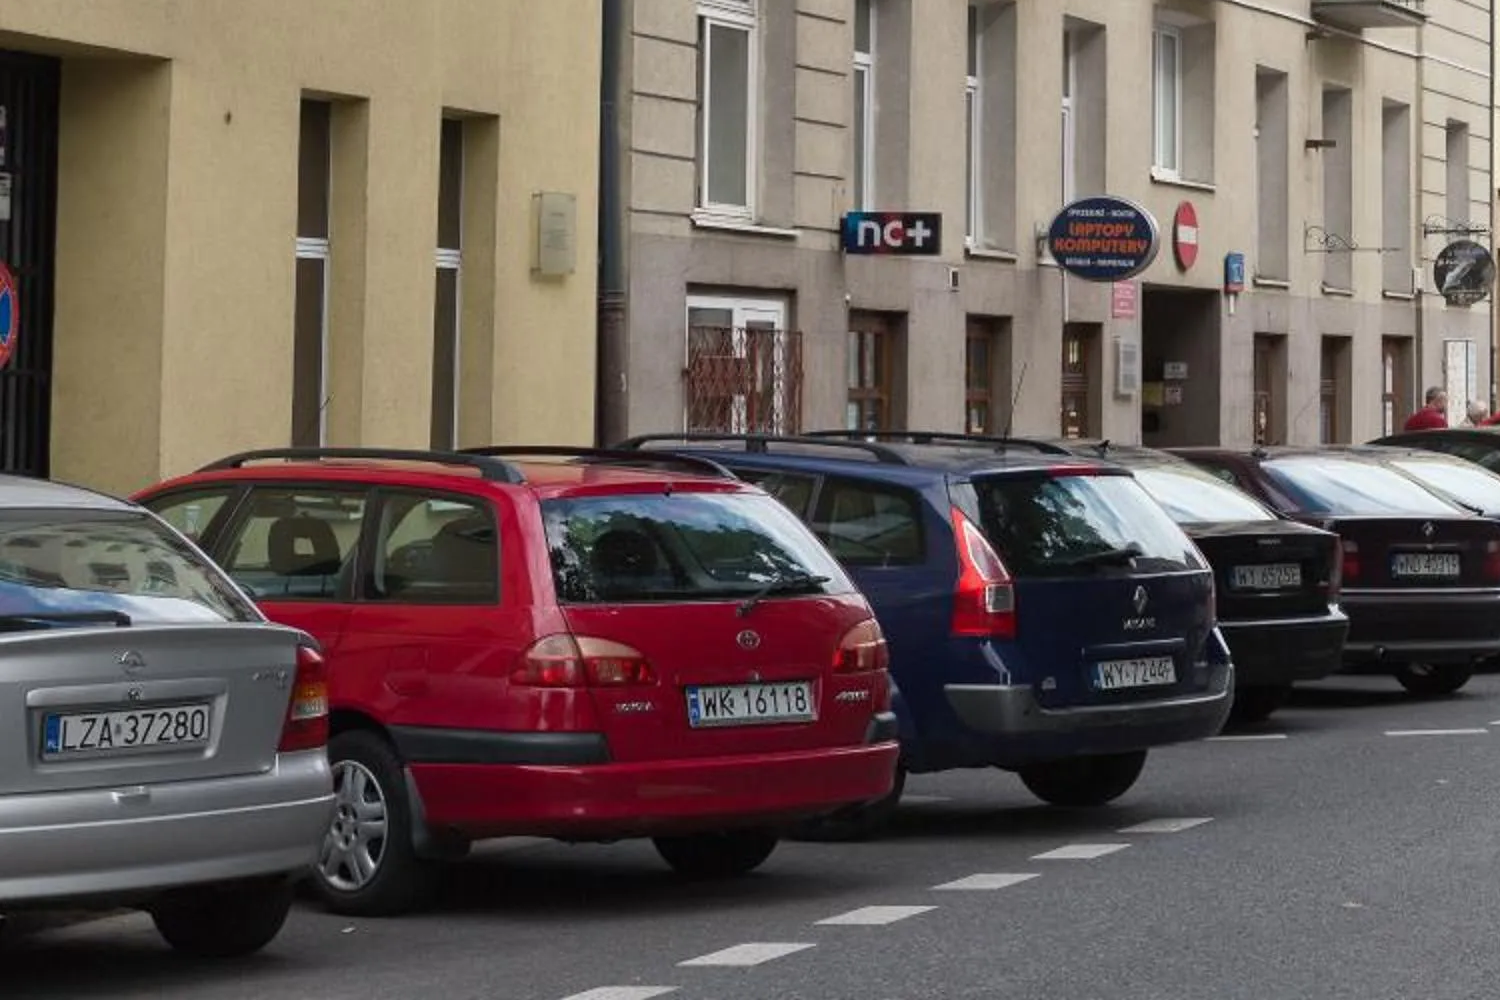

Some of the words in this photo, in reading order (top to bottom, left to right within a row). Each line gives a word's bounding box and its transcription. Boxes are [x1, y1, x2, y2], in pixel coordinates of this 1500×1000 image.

[857, 220, 931, 247] nc+
[1069, 221, 1135, 237] LAPTOPY
[1054, 237, 1148, 253] KOMPUTERY
[702, 689, 734, 718] WK
[743, 685, 809, 715] 16118
[61, 716, 114, 750] LZA
[123, 707, 207, 745] 37280
